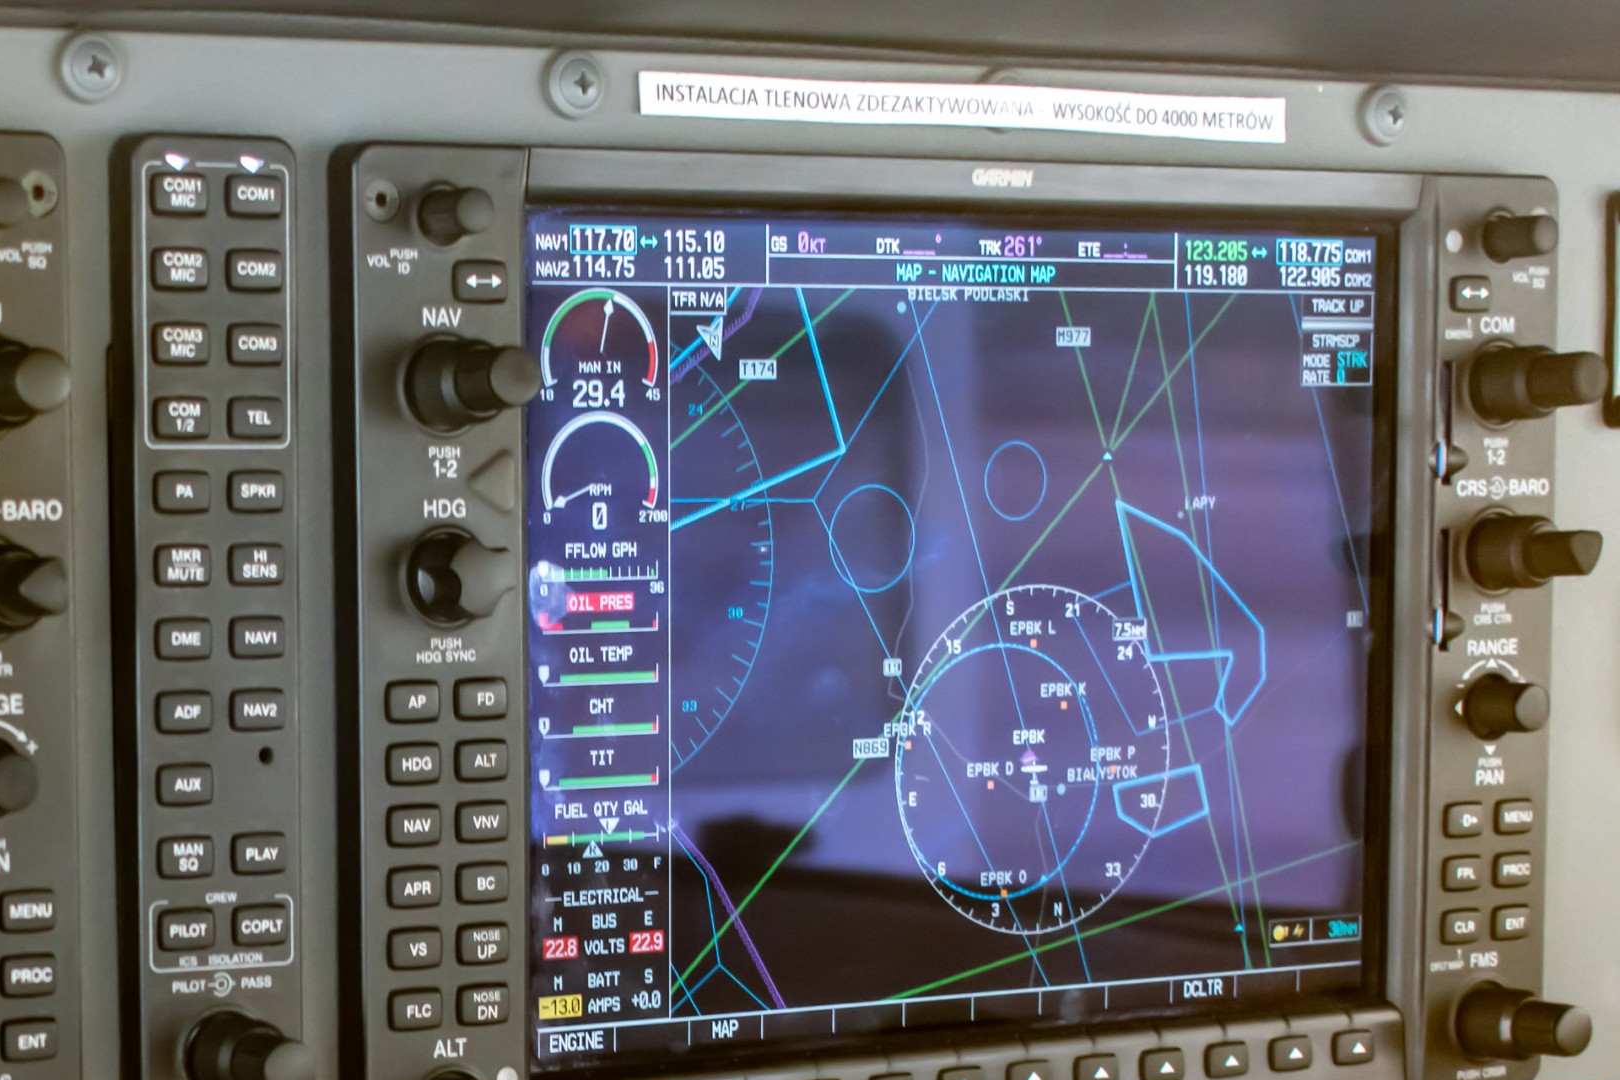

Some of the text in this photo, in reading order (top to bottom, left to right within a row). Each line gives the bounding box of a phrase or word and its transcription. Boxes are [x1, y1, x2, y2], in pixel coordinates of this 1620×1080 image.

[656, 83, 759, 106] INSTALACJA
[764, 88, 851, 111] TLENOWA
[856, 93, 1034, 117] ZDEZAKTYWOWANA
[1052, 101, 1132, 124] WYSOKOŚĆ
[1136, 107, 1157, 124] DO
[1161, 109, 1198, 127] 4000
[1202, 109, 1274, 130] METRÓW
[170, 193, 196, 208] MIC
[237, 185, 275, 201] COM1
[536, 228, 725, 254] NAV1 117.70 115.10
[771, 236, 787, 252] GS
[876, 238, 899, 254] DTK
[979, 240, 1001, 256] TRK
[390, 248, 418, 261] PUSH
[1078, 242, 1101, 257] ETE
[1185, 240, 1248, 261] 123.205
[1279, 241, 1372, 264] 118.775 COM1
[237, 261, 276, 277] COM2
[367, 254, 390, 268] VOL
[536, 256, 725, 280] NAV2 114.75 111.05
[170, 268, 196, 283] MIC
[896, 264, 922, 282] MAP
[942, 265, 1026, 283] NAVIGATION
[1030, 266, 1056, 283] MAP
[1184, 264, 1248, 285] 119.180
[1279, 266, 1372, 288] 122.905 COM2
[673, 291, 724, 308] TFR N/A
[422, 307, 461, 327] NAV
[1480, 317, 1515, 334] COM
[170, 343, 195, 358] MIC
[238, 336, 277, 351] COM3
[579, 361, 621, 375] MAN IN
[572, 380, 626, 408] 29.4
[168, 402, 200, 417] COM
[247, 410, 271, 426] TEL
[428, 446, 460, 459] PUSH
[433, 460, 458, 478] 1-2
[240, 483, 275, 499] SPKR
[589, 483, 612, 497] RPM
[1509, 478, 1549, 496] BARO
[2, 499, 63, 521] BARO
[424, 499, 467, 518] HDG
[565, 541, 638, 560] FFLOW GPH
[242, 564, 277, 579] SENS
[568, 595, 634, 613] OIL PRES
[171, 632, 201, 646] DME
[244, 630, 276, 645] NAV1
[430, 638, 462, 650] PUSH
[569, 646, 635, 663] OIL TEMP
[1467, 638, 1518, 656] RANGE
[416, 649, 476, 664] HDG SYNC
[174, 705, 201, 719] ADF
[243, 703, 277, 718] NAV2
[589, 699, 614, 716] CHT
[854, 741, 888, 757] N869
[402, 757, 432, 772] HDG
[474, 753, 497, 768] ALT
[590, 750, 615, 767] TIT
[174, 778, 201, 792] AUX
[554, 800, 649, 820] FUEL QTY GAL
[403, 818, 431, 833] NAV
[473, 815, 499, 830] VNV
[246, 847, 278, 862] PLAY
[404, 881, 431, 896] APR
[563, 887, 645, 907] ELECTRICAL
[9, 902, 53, 919] MENU
[170, 923, 207, 938] PILOT
[241, 920, 283, 935] COPLT
[1183, 980, 1223, 999] DCLTR
[587, 997, 622, 1014] AMPS
[631, 992, 662, 1010] +0.0
[406, 1004, 432, 1019] FLC
[711, 1021, 739, 1038] MAP
[433, 1038, 467, 1059] ALT
[549, 1031, 604, 1052] ENGINE
